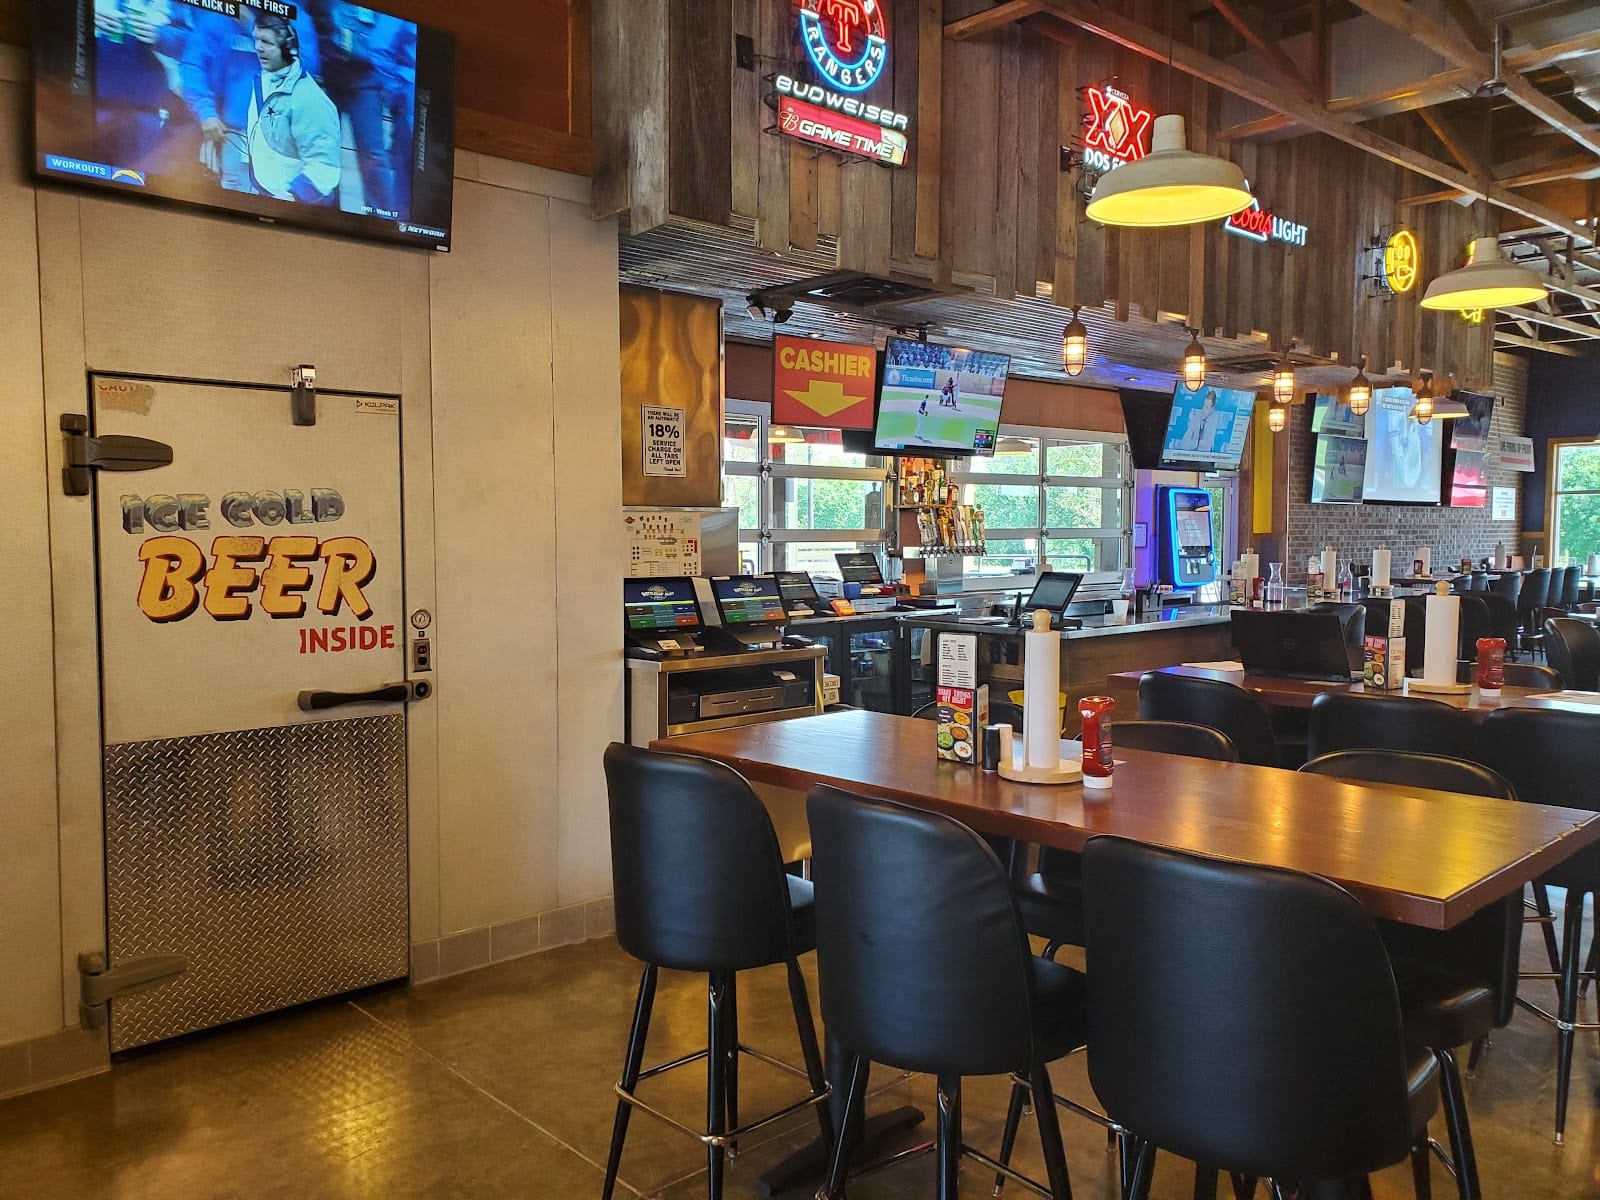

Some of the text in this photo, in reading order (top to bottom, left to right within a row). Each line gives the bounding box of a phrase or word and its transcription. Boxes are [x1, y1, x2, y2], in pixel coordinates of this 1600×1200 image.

[225, 4, 236, 16] IS
[264, 0, 290, 17] FIRST
[807, 26, 882, 85] RANGERS
[776, 75, 908, 131] BUDWEISER
[798, 120, 853, 147] GAME
[852, 136, 895, 159] TIME
[51, 158, 106, 176] WORKOUTS
[1084, 146, 1111, 171] DOS
[376, 208, 391, 217] Week
[1231, 207, 1308, 247] Coors LIGHT
[407, 225, 446, 237] NETWORK
[779, 346, 871, 377] CASHIER
[649, 424, 680, 438] 18%
[120, 487, 346, 534] ICE COLD
[136, 535, 377, 623] BEER
[299, 625, 395, 654] INSIDE
